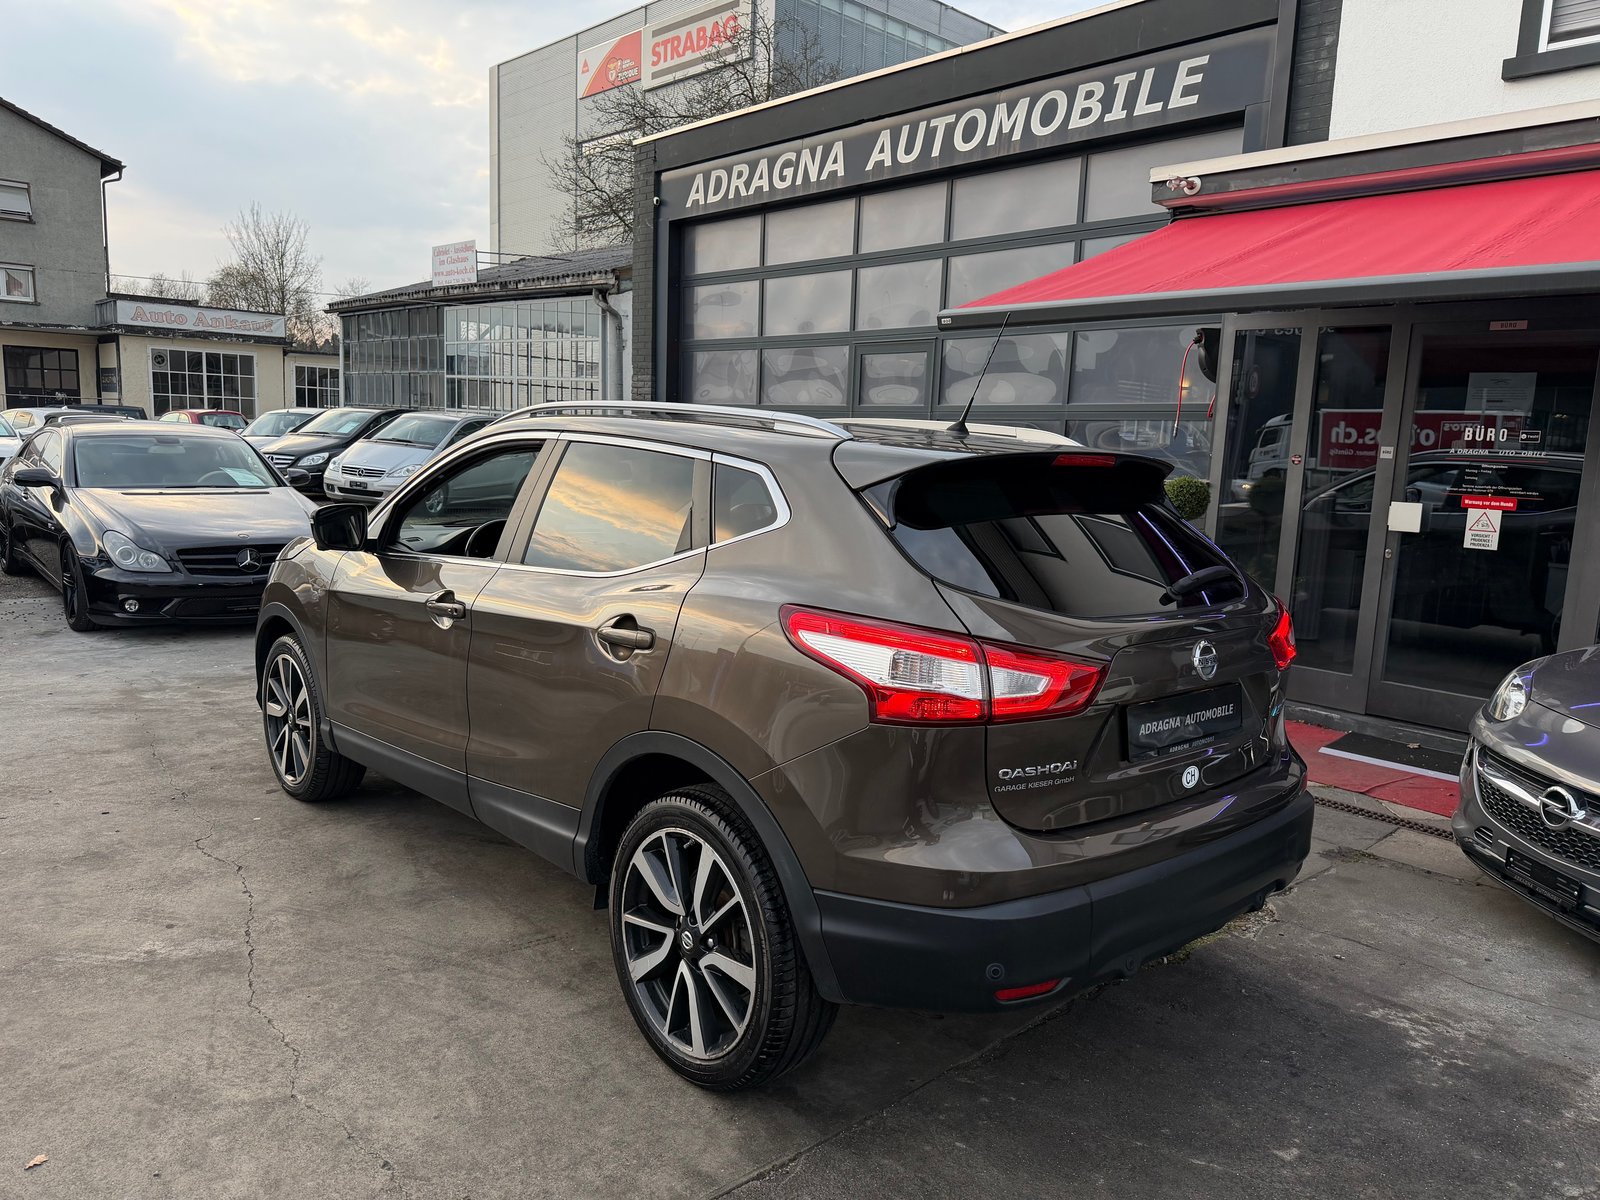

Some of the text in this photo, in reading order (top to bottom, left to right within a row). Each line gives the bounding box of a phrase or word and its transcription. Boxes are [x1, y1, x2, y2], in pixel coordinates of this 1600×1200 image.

[651, 15, 741, 67] STRABAG
[685, 54, 1211, 208] ADRAGNA AUTOMOBILE
[131, 305, 274, 333] Auto Ankauf
[1464, 425, 1508, 442] BÜRO
[1138, 703, 1234, 736] ADRAGNA AUTOMOBILE
[1169, 736, 1215, 753] ADRAGNA AUTOMOBILE
[994, 776, 1075, 793] GARAGE KIESER GmbH
[1185, 769, 1196, 785] CH
